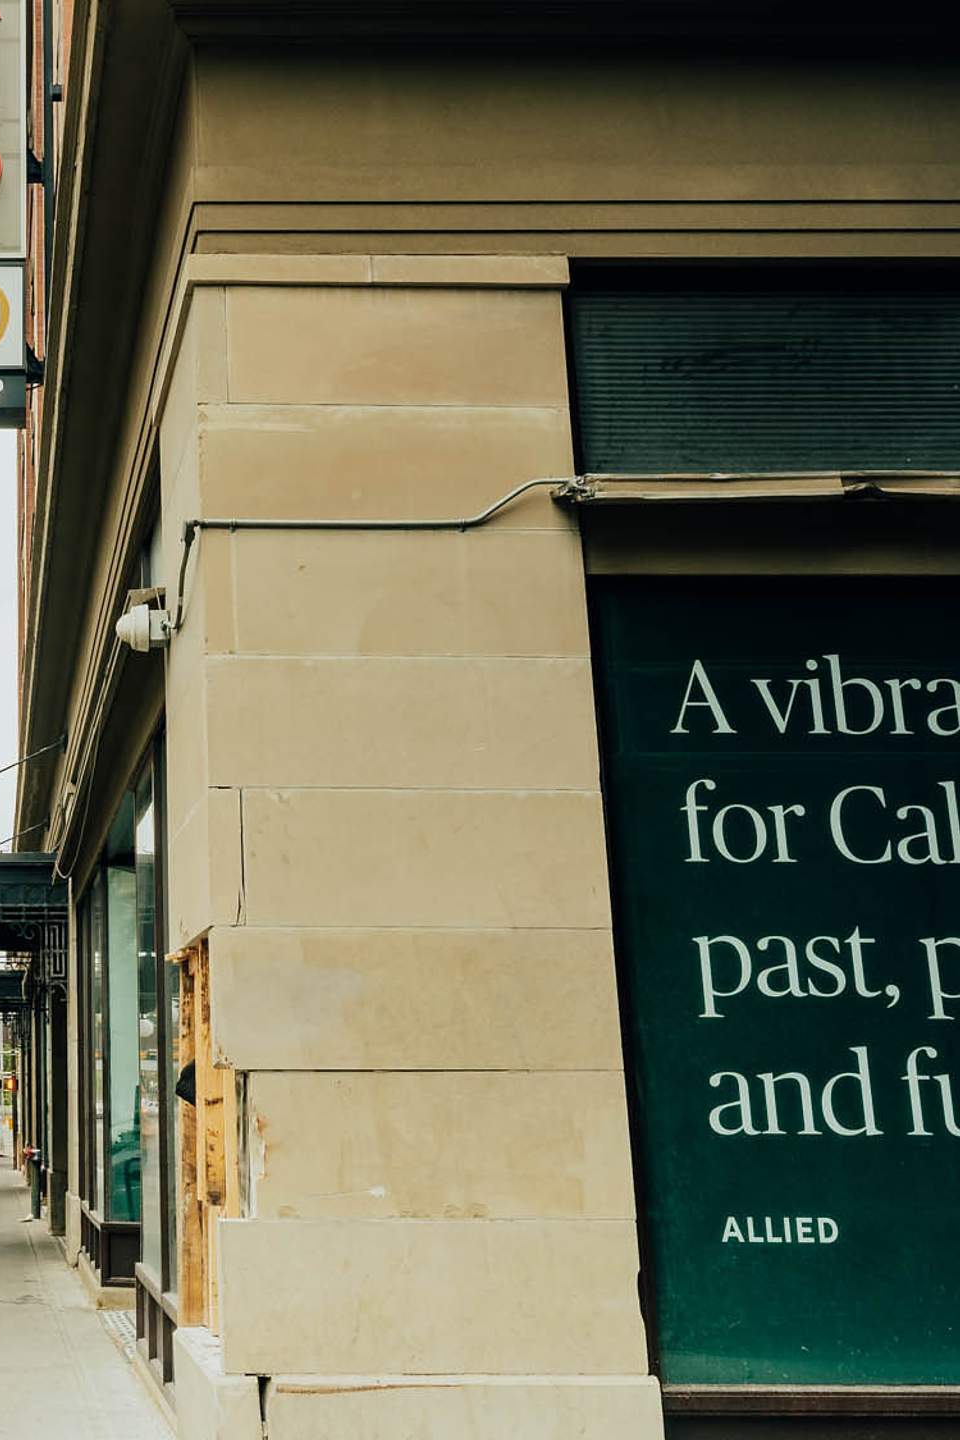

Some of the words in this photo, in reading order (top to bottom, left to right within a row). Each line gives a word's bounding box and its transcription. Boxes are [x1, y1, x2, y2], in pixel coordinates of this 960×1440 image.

[669, 659, 737, 734] A
[750, 654, 960, 736] vibra
[680, 779, 806, 863] for
[829, 780, 960, 865] Cal
[691, 925, 900, 1018] past,
[708, 1045, 884, 1137] and
[721, 1216, 839, 1244] ALLIED
